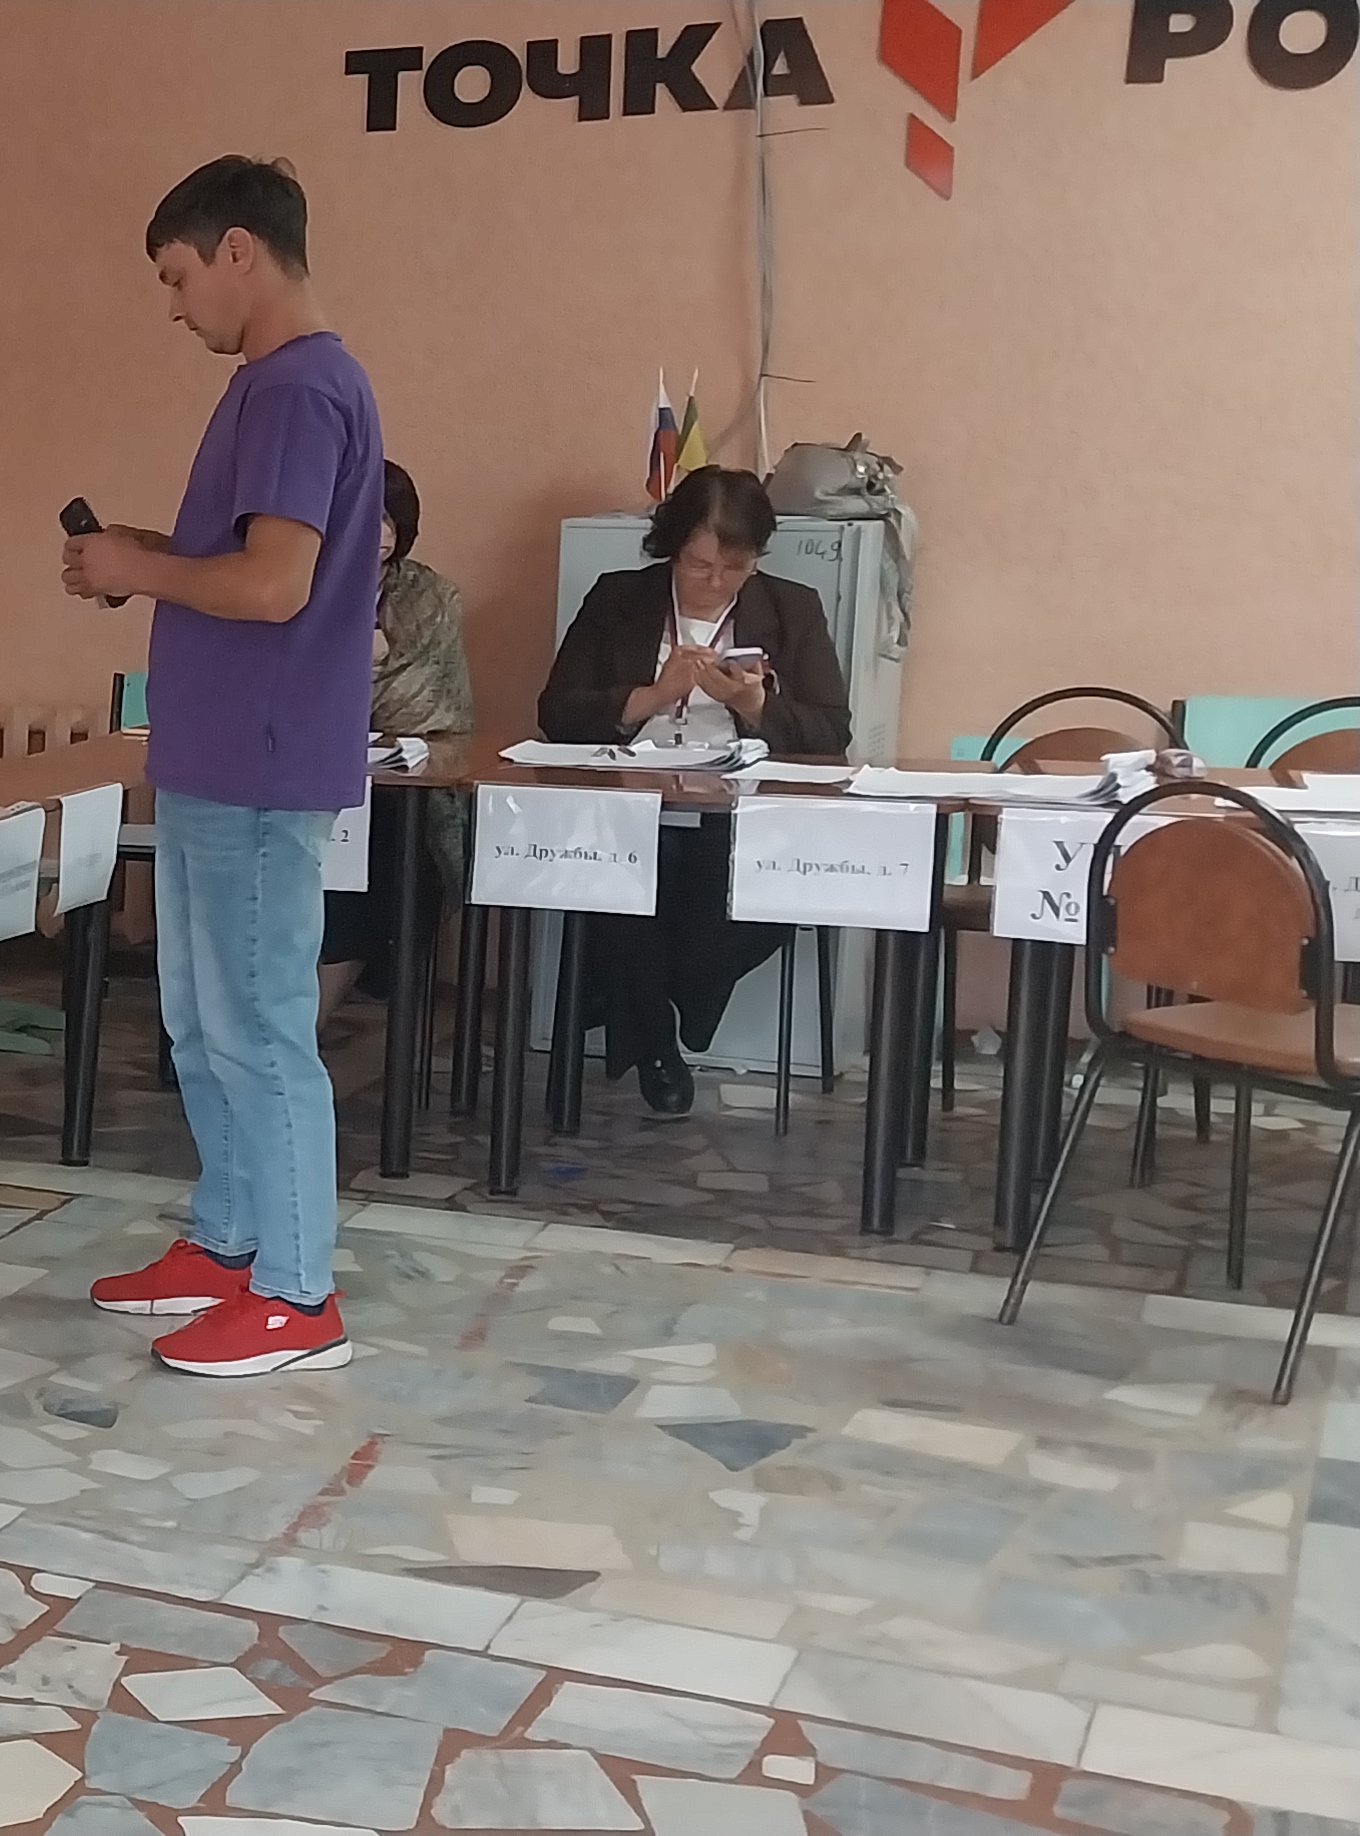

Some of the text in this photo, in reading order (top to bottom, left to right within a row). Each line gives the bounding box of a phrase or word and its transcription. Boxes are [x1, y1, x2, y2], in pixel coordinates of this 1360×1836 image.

[344, 15, 835, 134] ТОЧКА
[627, 850, 638, 864] 6
[898, 862, 910, 876] 7
[1030, 889, 1080, 923] №
